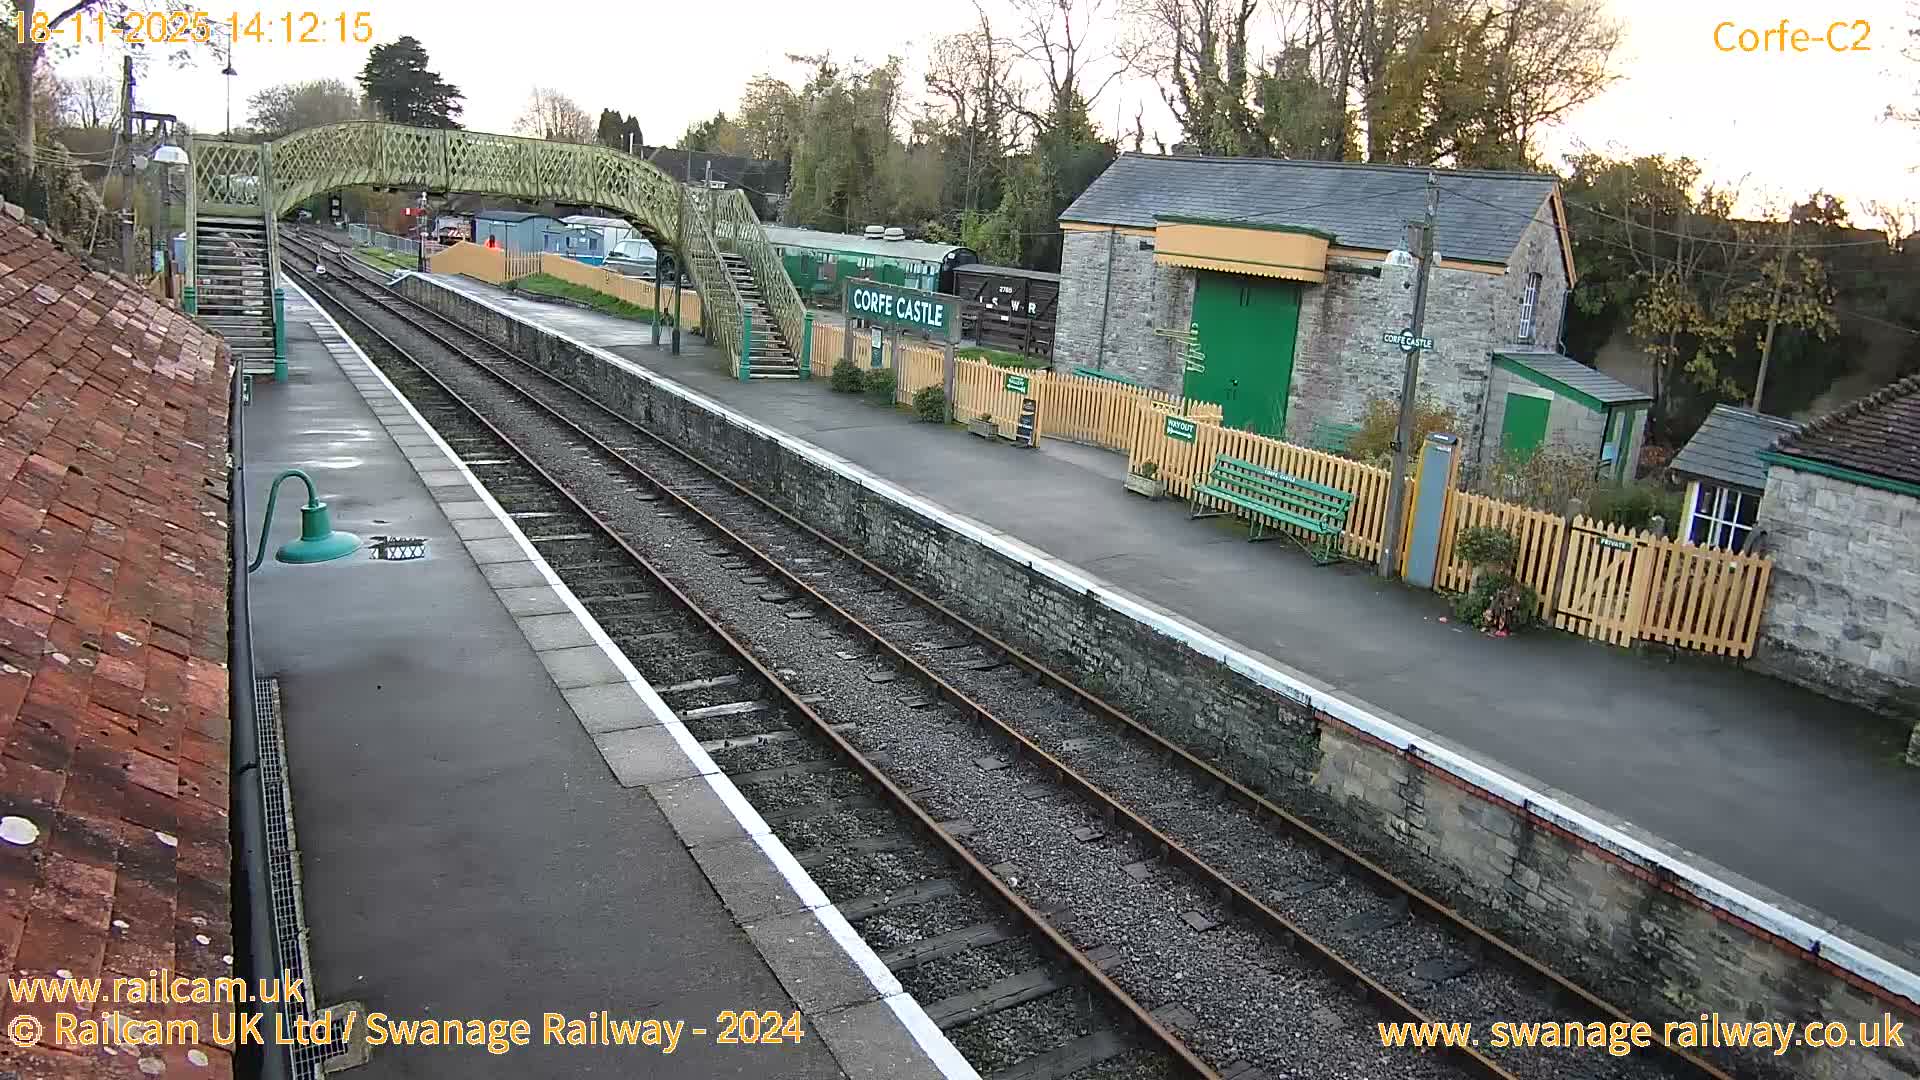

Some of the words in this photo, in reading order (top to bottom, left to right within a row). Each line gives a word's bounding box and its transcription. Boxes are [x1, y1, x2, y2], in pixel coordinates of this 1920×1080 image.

[853, 288, 893, 316] CORFE
[896, 296, 944, 327] CASTLE
[1011, 299, 1020, 312] W
[1028, 302, 1037, 314] R
[1384, 334, 1406, 345] CORFE
[1406, 337, 1433, 349] CASTLE
[1167, 418, 1181, 428] WAY
[1180, 422, 1194, 433] OUT
[1600, 538, 1626, 549] PRIVATE
